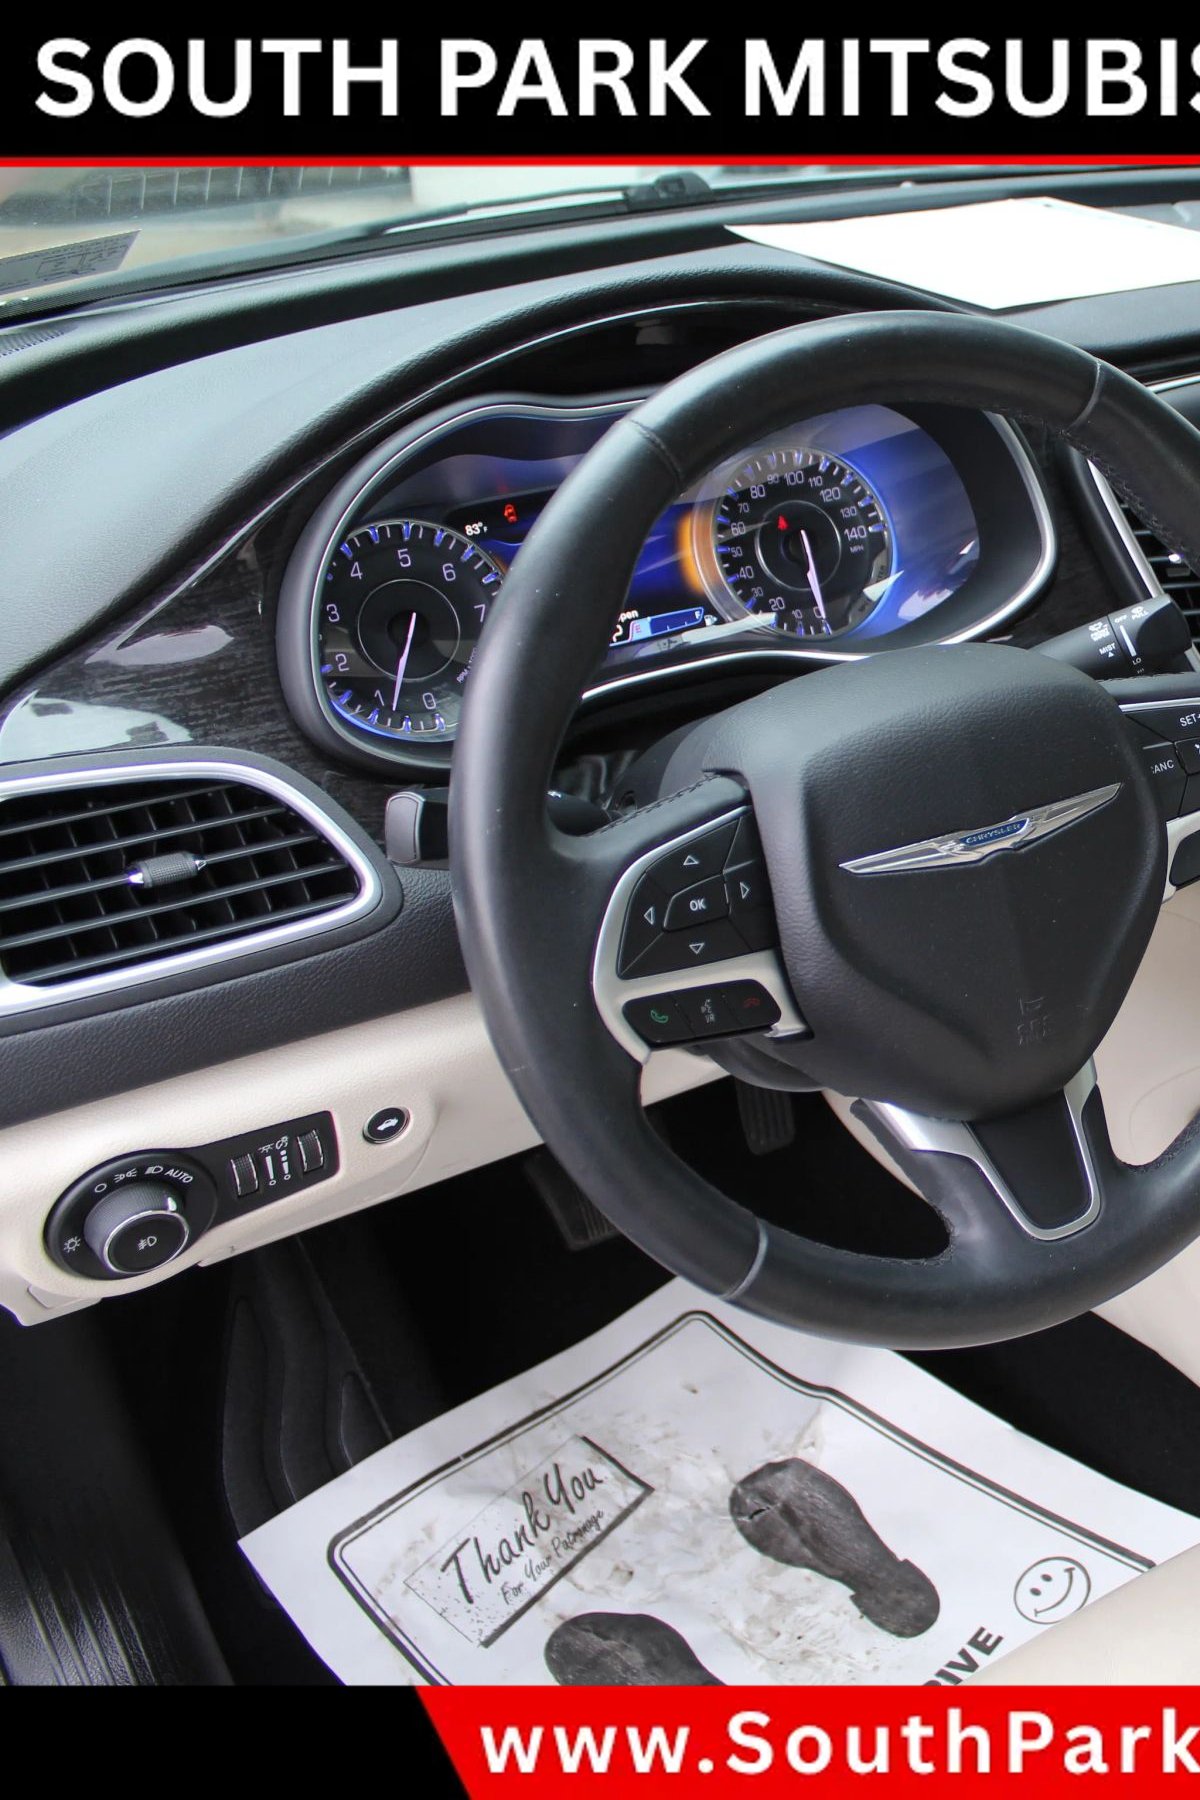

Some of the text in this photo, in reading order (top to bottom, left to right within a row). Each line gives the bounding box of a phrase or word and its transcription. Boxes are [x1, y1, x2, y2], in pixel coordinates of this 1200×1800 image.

[767, 474, 779, 484] 90
[784, 471, 804, 486] 100
[808, 475, 823, 488] 110
[750, 485, 766, 499] 80
[819, 487, 840, 502] 120
[738, 503, 749, 513] 70
[840, 506, 857, 519] 130
[730, 522, 746, 535] 60
[844, 526, 867, 541] 140
[398, 549, 412, 567] 5
[730, 547, 743, 558] 50
[350, 562, 363, 579] 4
[442, 563, 456, 581] 6
[739, 566, 754, 579] 40
[751, 587, 763, 598] 30
[768, 597, 785, 611] 20
[326, 604, 340, 622] 3
[474, 604, 486, 623] 7
[694, 610, 701, 620] F
[792, 609, 802, 620] 10
[1099, 642, 1116, 655] MIST
[336, 654, 349, 672] 2
[1132, 657, 1142, 666] LO
[374, 689, 385, 706] 1
[423, 692, 436, 710] 0
[965, 823, 1021, 844] CHRYSLER
[689, 898, 706, 912] OK
[164, 1168, 194, 1183] AUTO
[441, 1463, 603, 1604] Thank You
[501, 1510, 604, 1606] For Your Patronage
